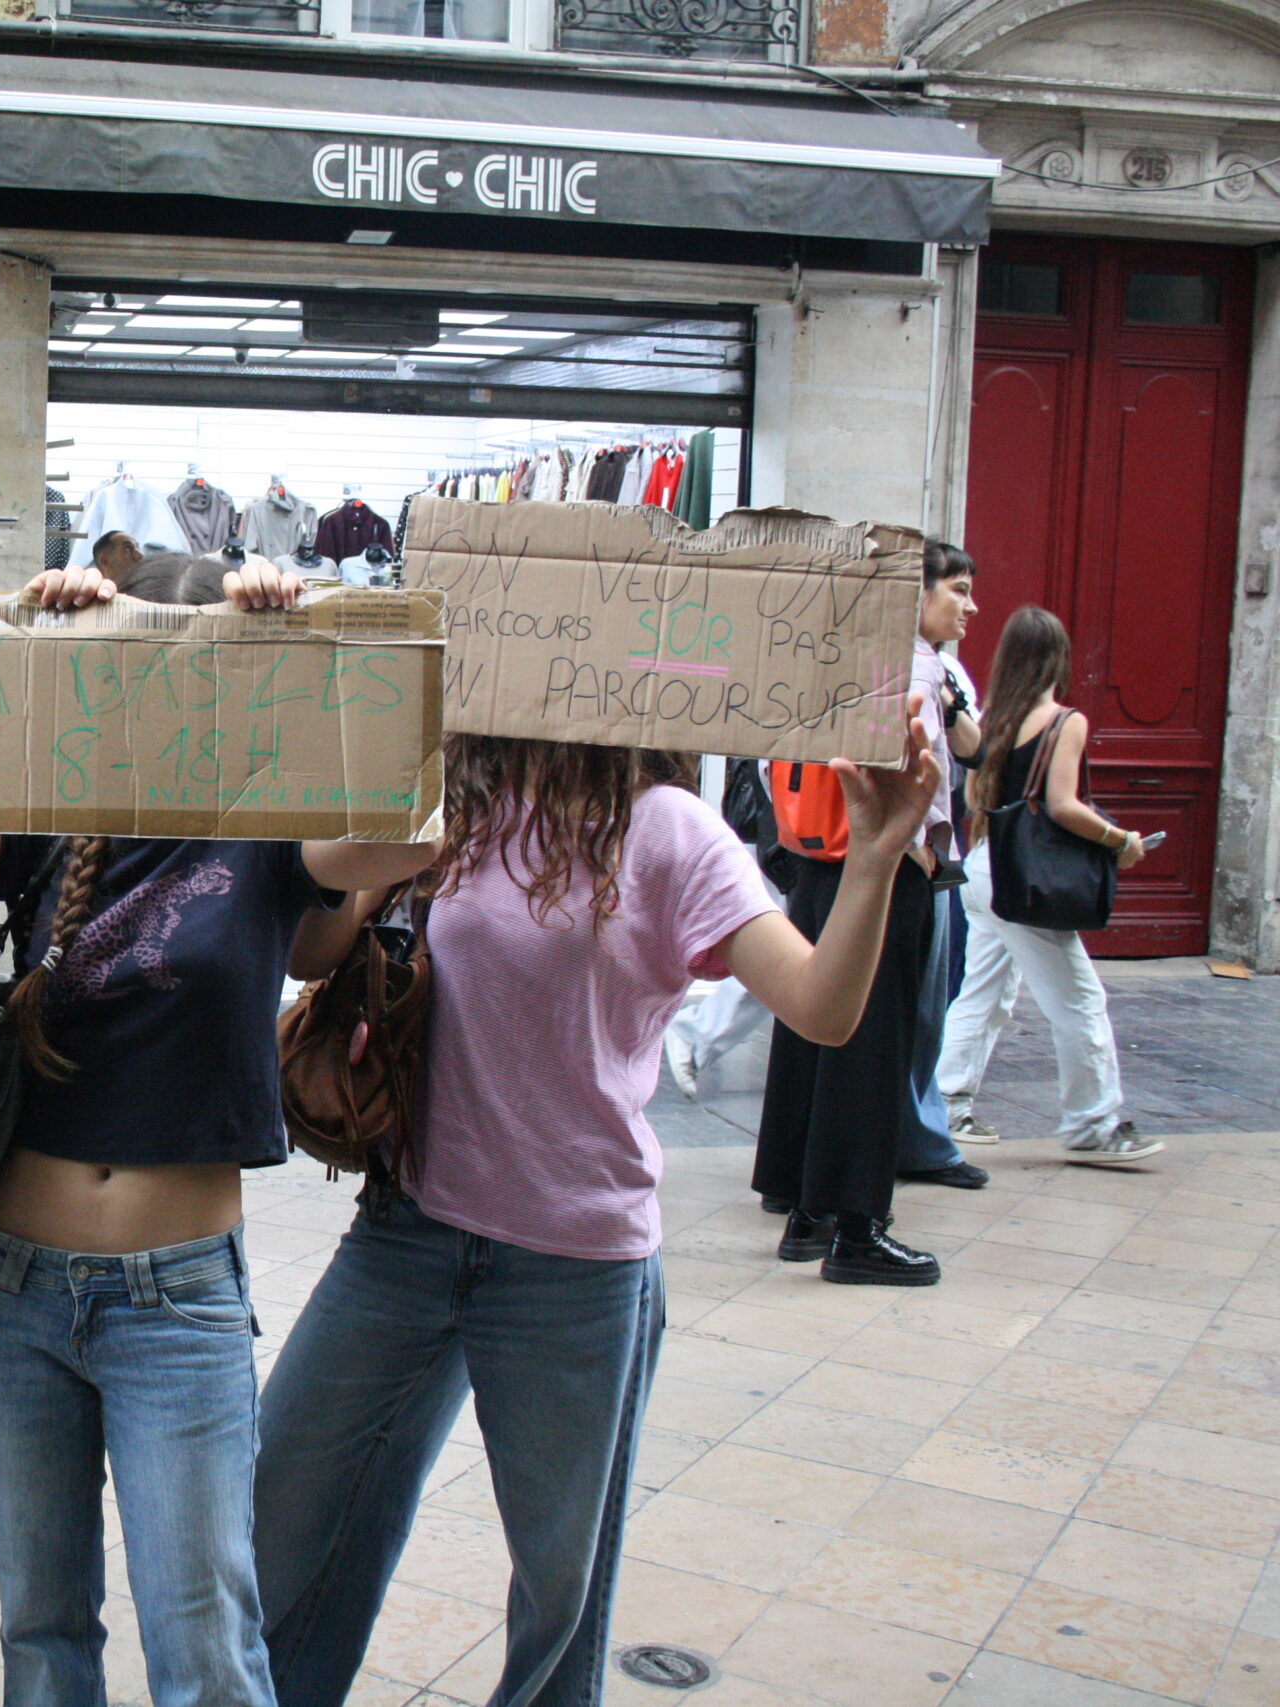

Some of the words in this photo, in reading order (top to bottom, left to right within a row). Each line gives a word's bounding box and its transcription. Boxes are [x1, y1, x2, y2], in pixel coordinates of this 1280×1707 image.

[312, 143, 439, 204] CHIC
[474, 154, 598, 215] CHIC
[1131, 155, 1167, 182] 215
[426, 530, 528, 594] ON
[593, 542, 728, 604] VEUT
[757, 556, 879, 627] UN
[768, 620, 841, 665] PAS
[68, 640, 232, 718] BAS
[245, 649, 405, 714] LES
[445, 656, 484, 708] N
[146, 783, 207, 805] AVEC
